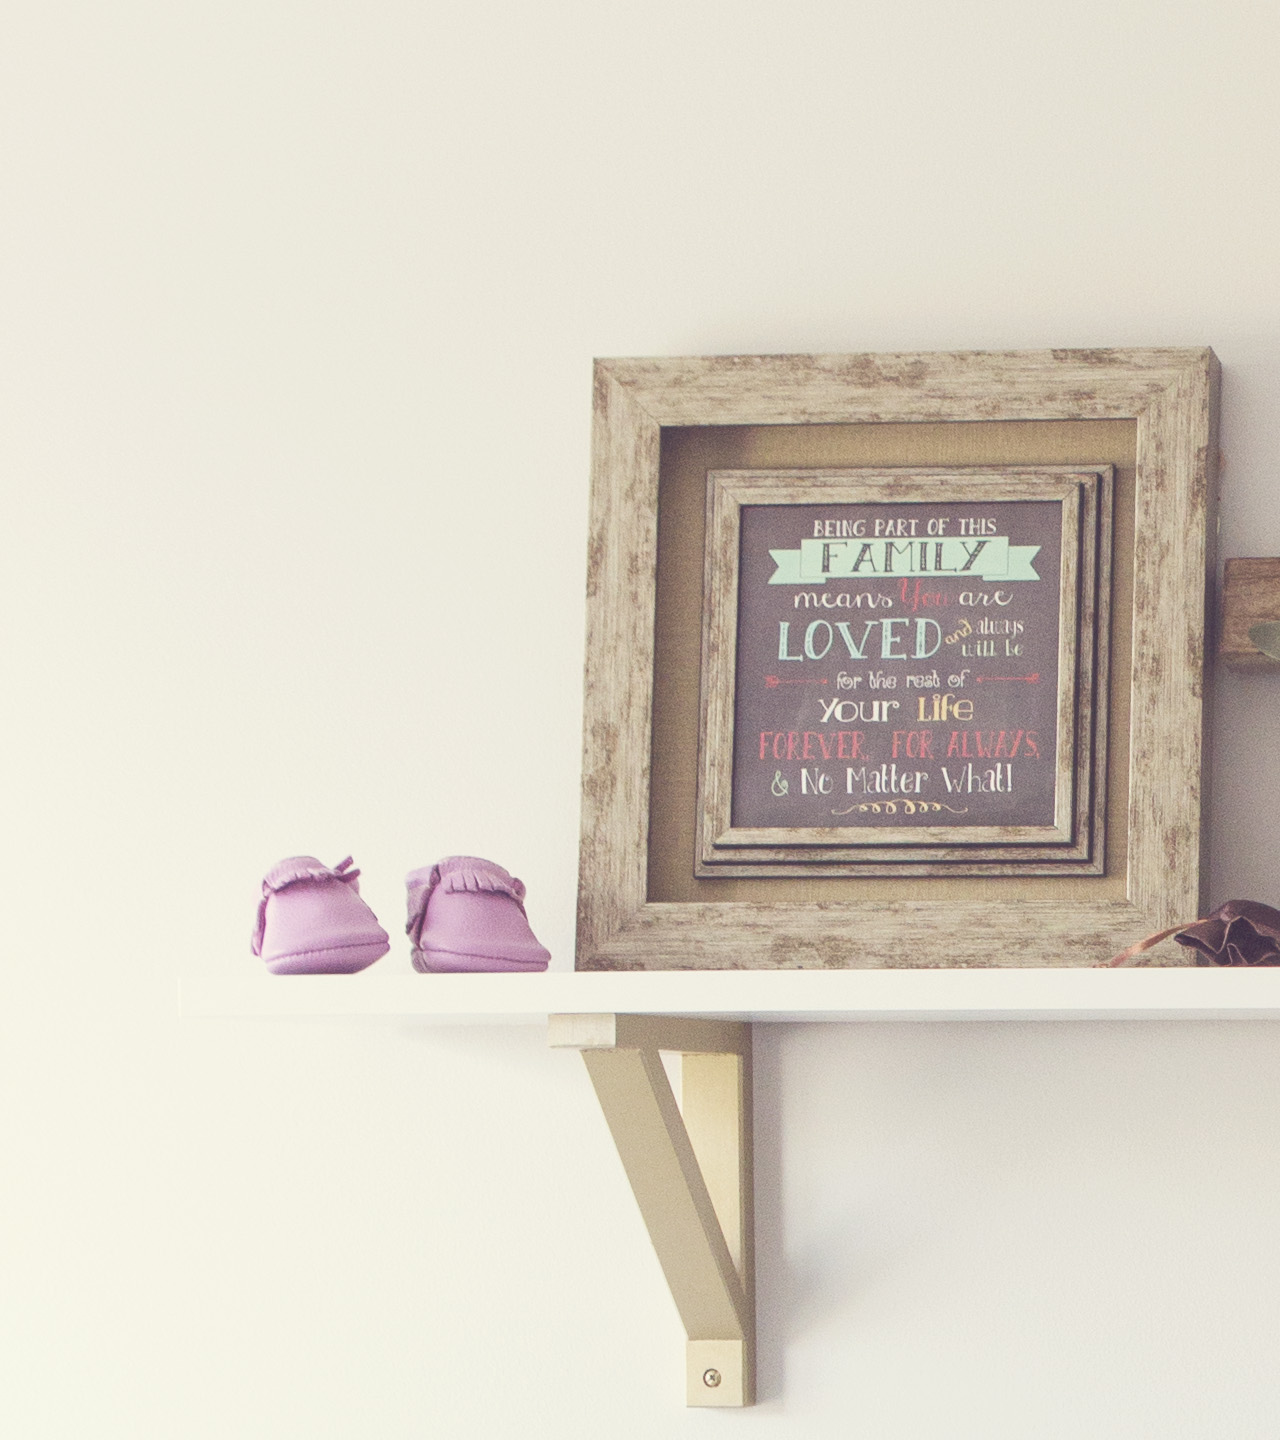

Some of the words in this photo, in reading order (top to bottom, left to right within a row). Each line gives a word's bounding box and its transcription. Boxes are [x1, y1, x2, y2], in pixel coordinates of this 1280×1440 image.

[814, 519, 866, 536] BEING
[874, 518, 919, 536] PART
[927, 518, 950, 535] OF
[959, 518, 997, 535] THIS
[821, 540, 991, 573] FAMILY
[794, 587, 893, 609] means
[897, 578, 951, 611] You
[959, 590, 1013, 607] are
[778, 618, 942, 662] LOVED
[945, 618, 972, 645] and
[975, 618, 1024, 639] always
[962, 641, 997, 658] will
[1005, 641, 1024, 657] be
[836, 671, 863, 690] for
[869, 671, 897, 689] the
[906, 671, 940, 689] rest
[948, 670, 971, 689] of
[759, 731, 870, 761] FOREVER,
[892, 731, 935, 759] FOR
[771, 770, 789, 797] &
[800, 767, 833, 794] No
[846, 763, 929, 795] Matter
[942, 763, 1013, 794] What!
